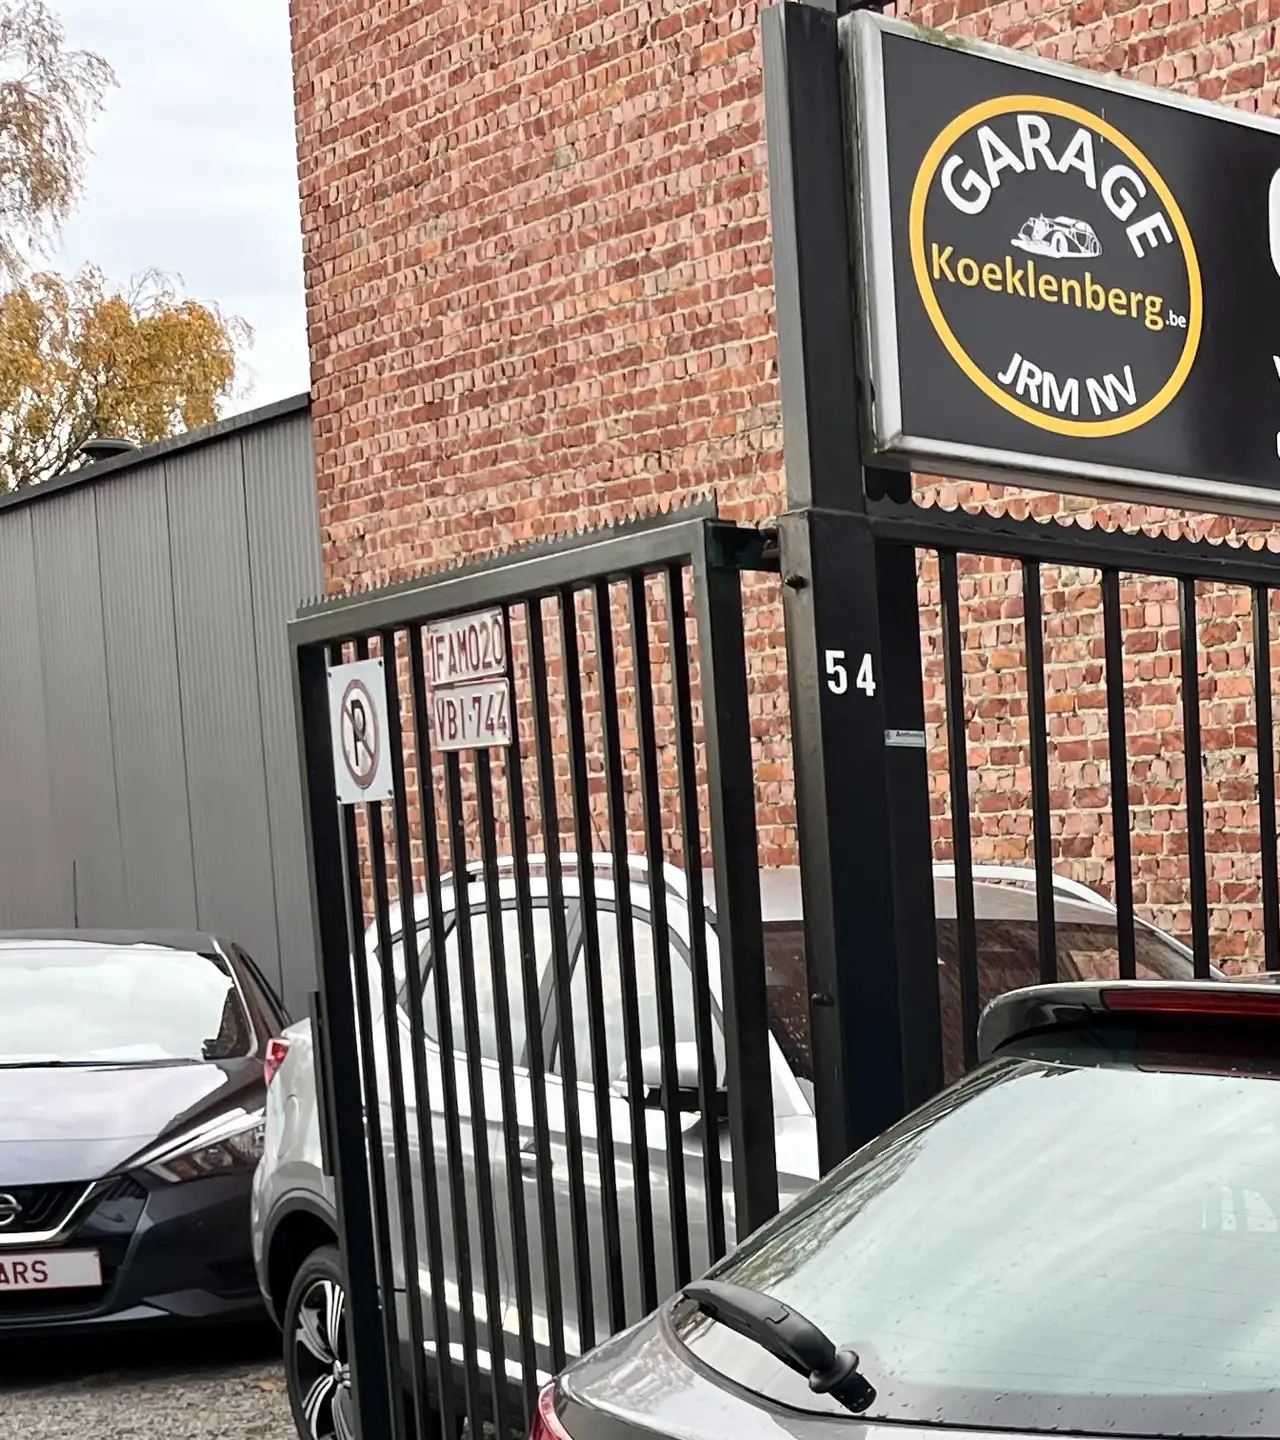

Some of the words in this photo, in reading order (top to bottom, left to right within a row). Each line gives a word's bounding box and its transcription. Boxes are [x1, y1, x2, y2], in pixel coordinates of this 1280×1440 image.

[941, 114, 1174, 258] GARAGE
[997, 352, 1079, 415] JRM
[1086, 364, 1138, 416] NV
[825, 649, 876, 697] 54
